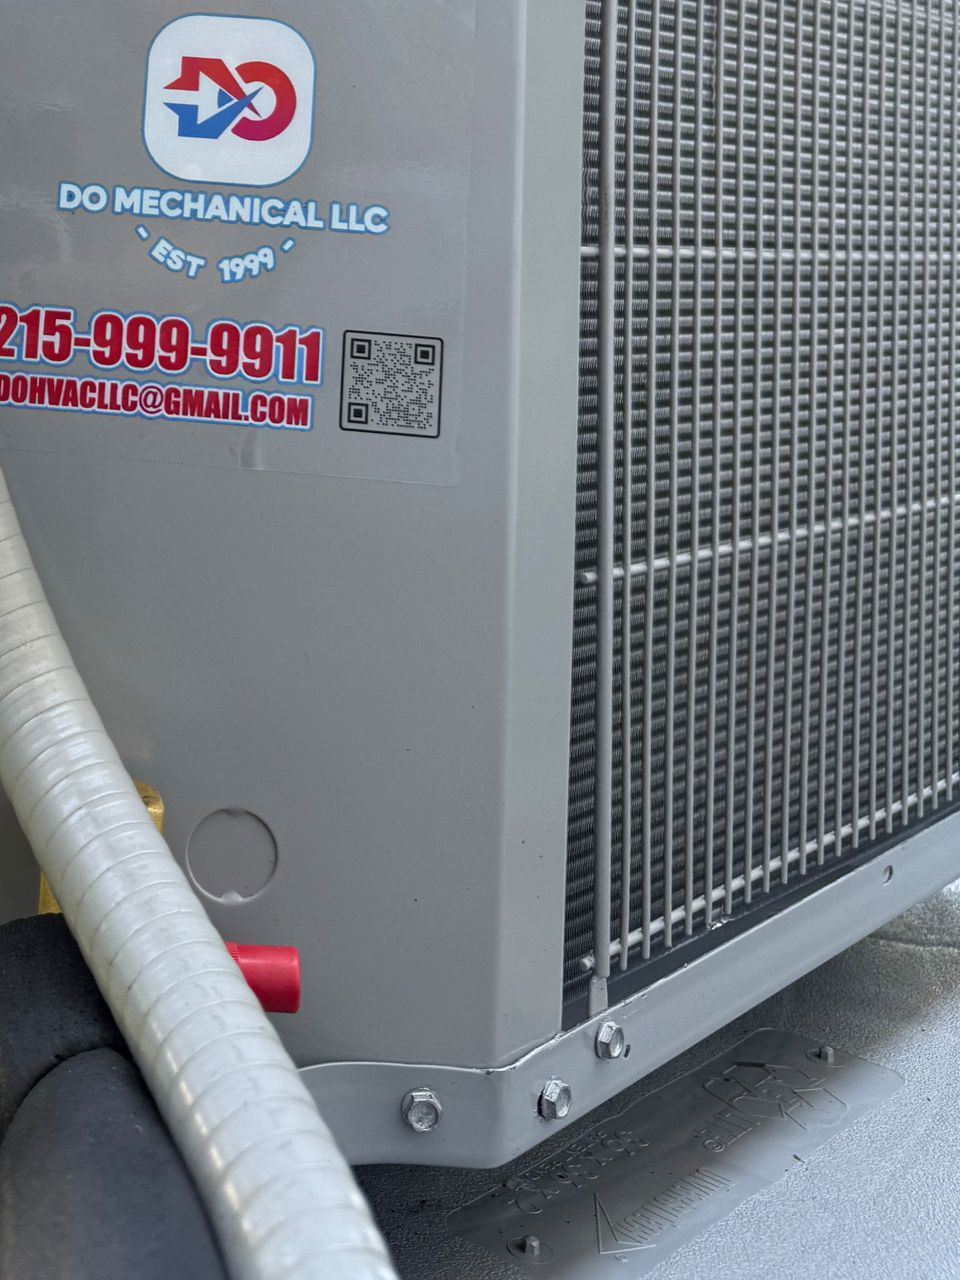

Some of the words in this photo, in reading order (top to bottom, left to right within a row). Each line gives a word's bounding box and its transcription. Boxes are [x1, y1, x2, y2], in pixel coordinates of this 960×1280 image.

[58, 183, 109, 212] DO
[114, 187, 324, 230] MECHANICAL
[330, 204, 390, 234] LLC
[149, 238, 206, 278] EST
[218, 247, 275, 284] 1999
